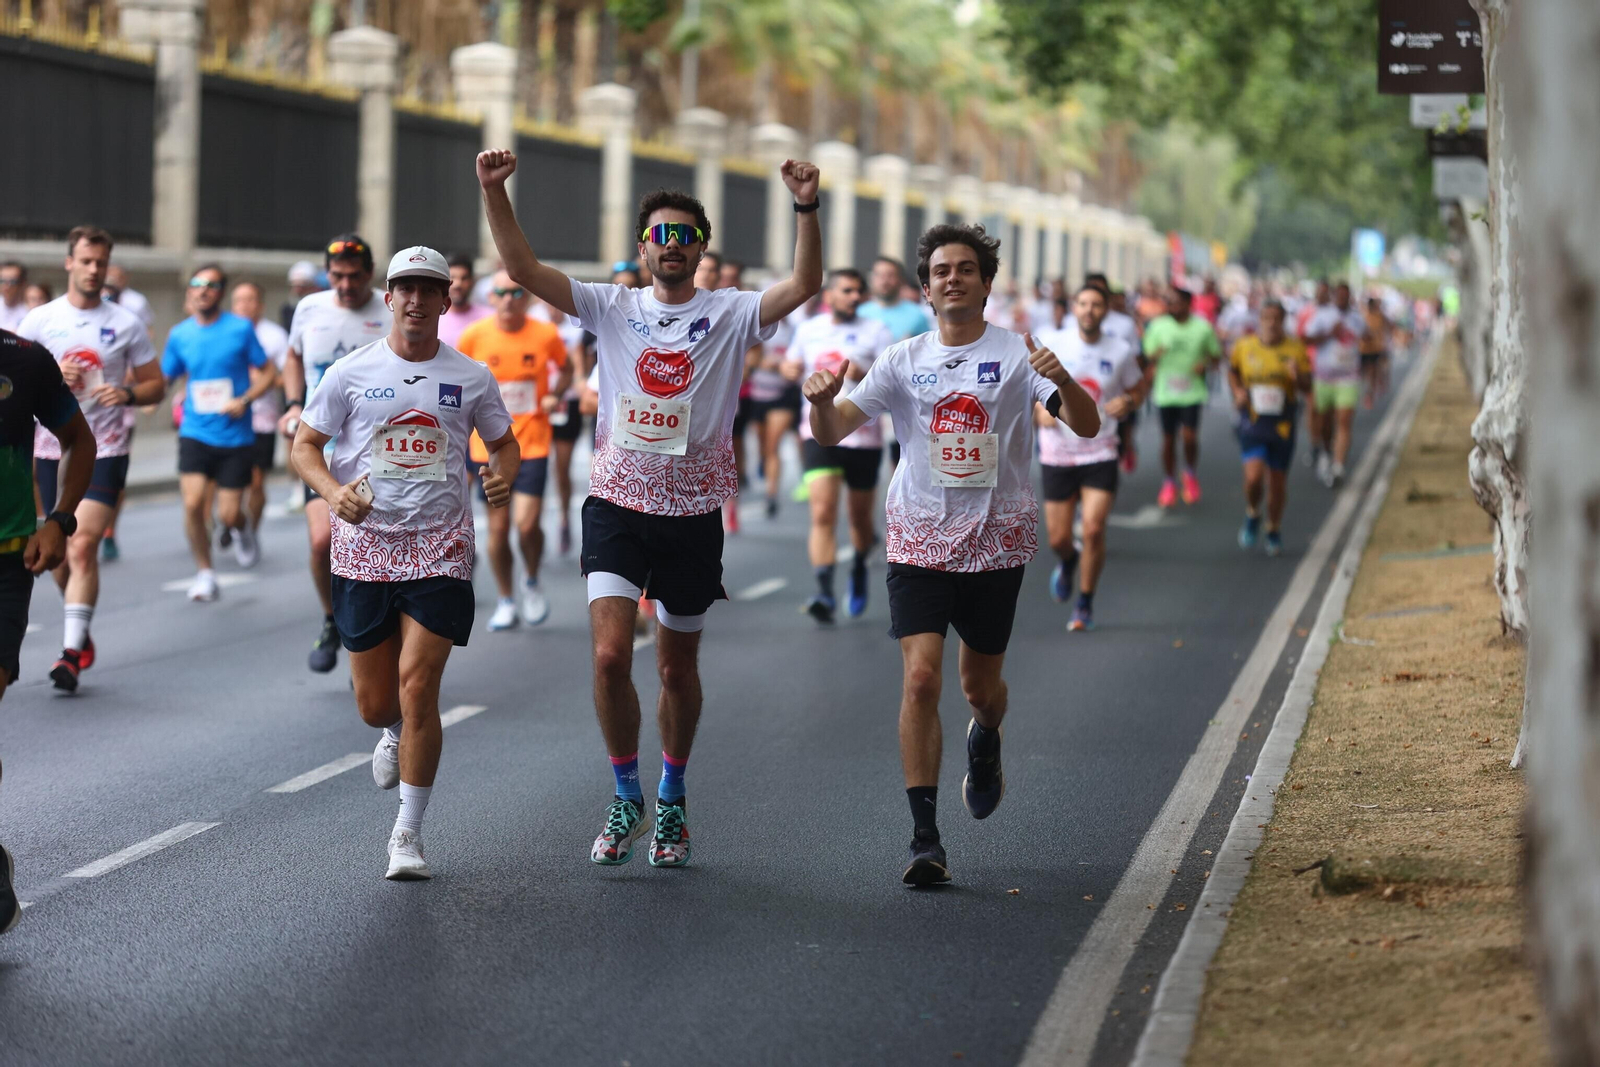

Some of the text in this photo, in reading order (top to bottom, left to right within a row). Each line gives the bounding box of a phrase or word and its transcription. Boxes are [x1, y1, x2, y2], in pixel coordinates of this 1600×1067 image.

[646, 355, 686, 375] PONLE
[642, 364, 683, 387] FRENO
[977, 371, 997, 382] AXA
[439, 394, 458, 406] AXA
[627, 409, 679, 429] 1280
[941, 408, 981, 425] PONLE
[938, 420, 979, 434] FRENO
[385, 437, 437, 454] 1166
[941, 447, 981, 461] 534
